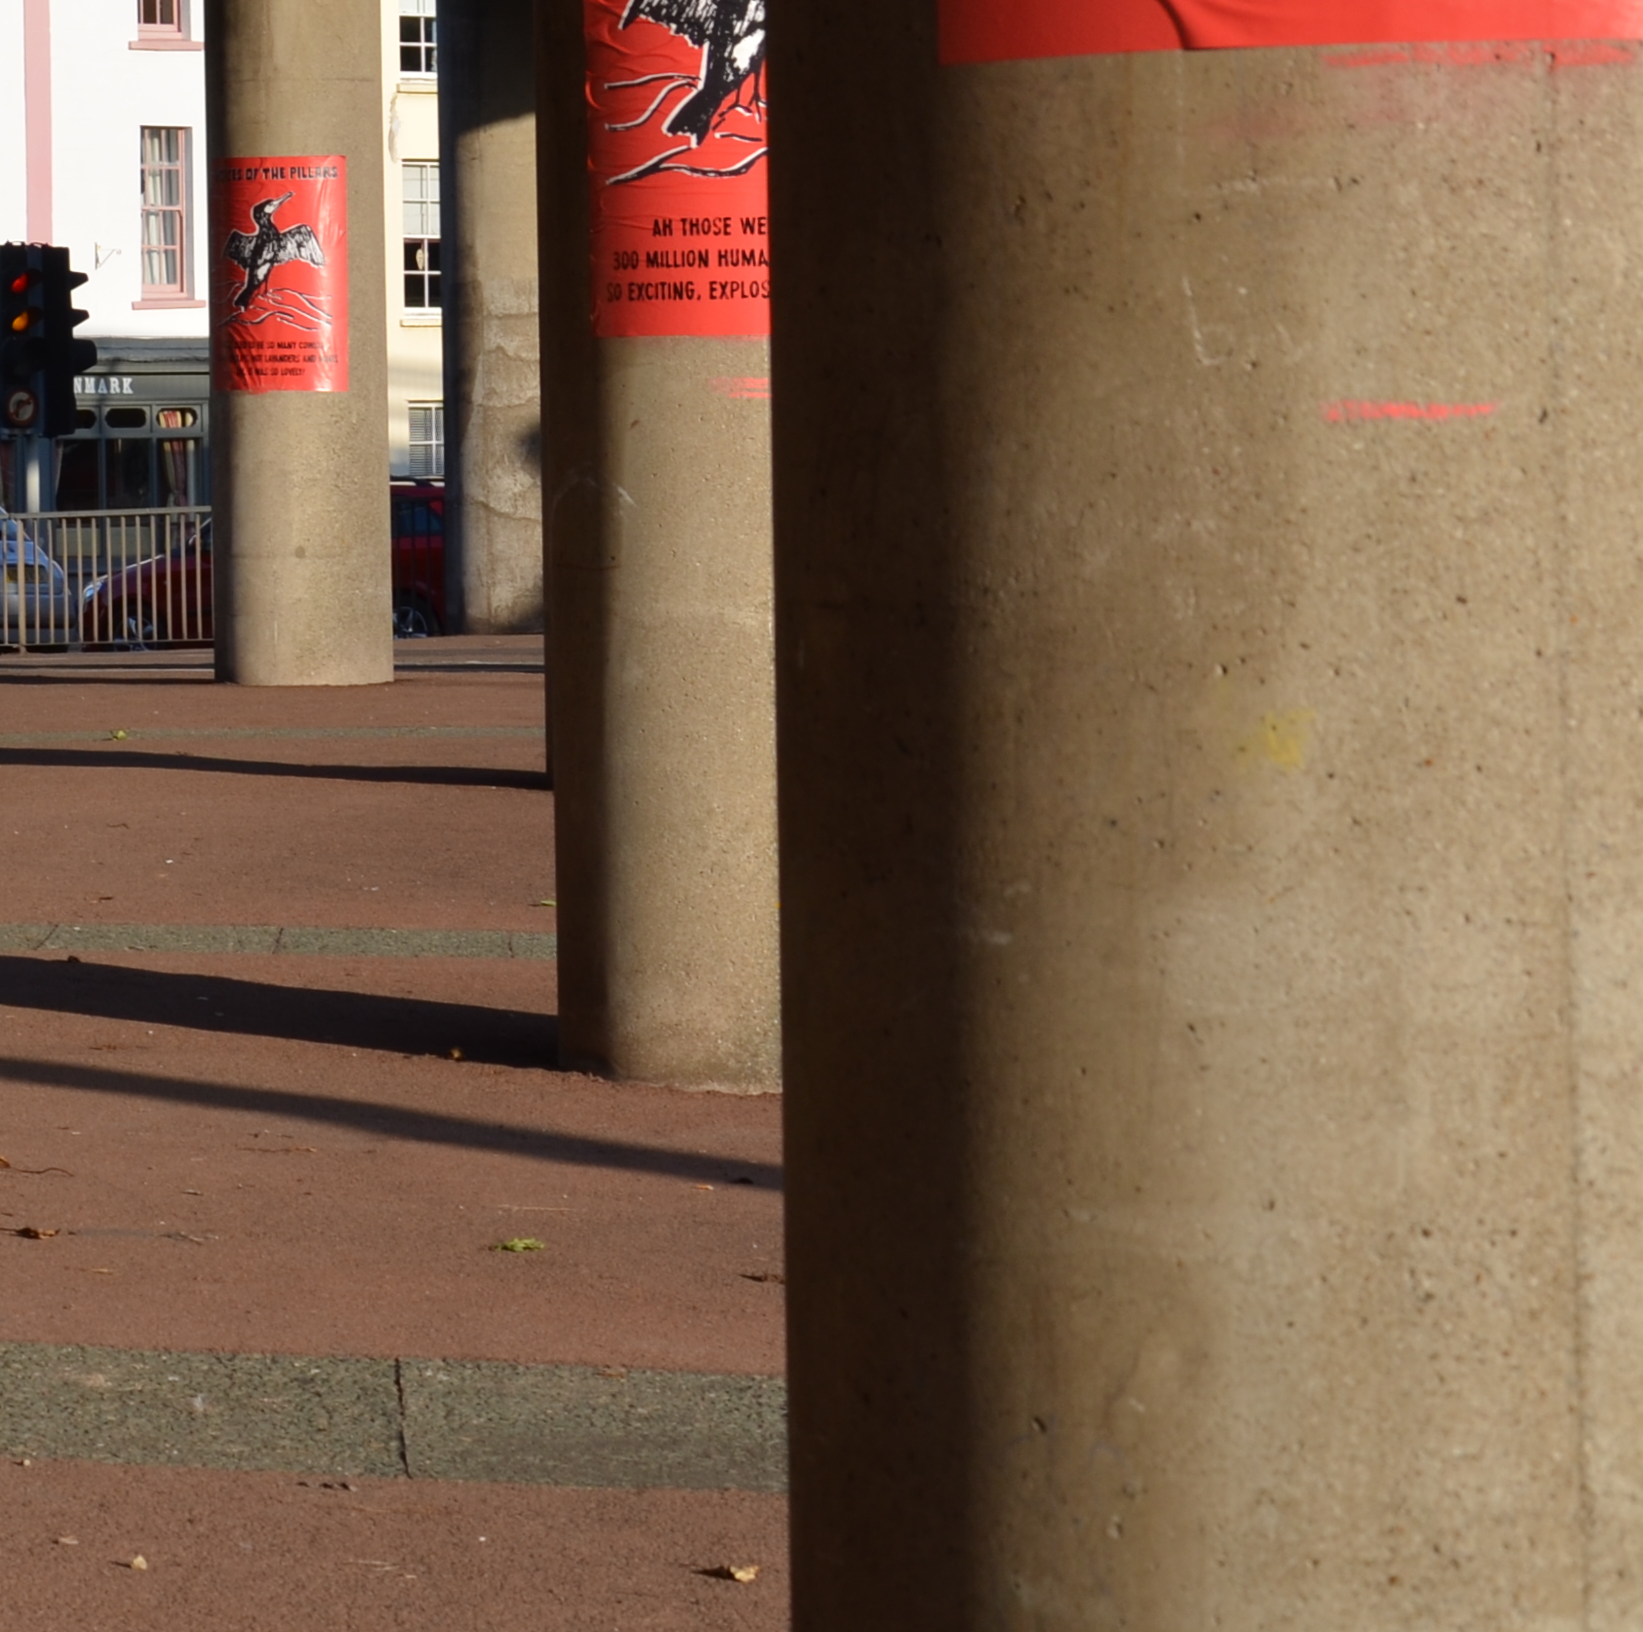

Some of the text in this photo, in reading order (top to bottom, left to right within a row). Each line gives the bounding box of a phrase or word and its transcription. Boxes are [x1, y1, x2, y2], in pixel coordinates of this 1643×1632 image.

[262, 166, 286, 180] THE
[289, 166, 339, 179] PILLARS
[652, 217, 673, 237] AH
[680, 216, 732, 237] THOSE
[613, 251, 638, 270] 300
[646, 249, 709, 269] MILLION
[606, 282, 622, 302] SO
[628, 280, 702, 301] EXCITING,
